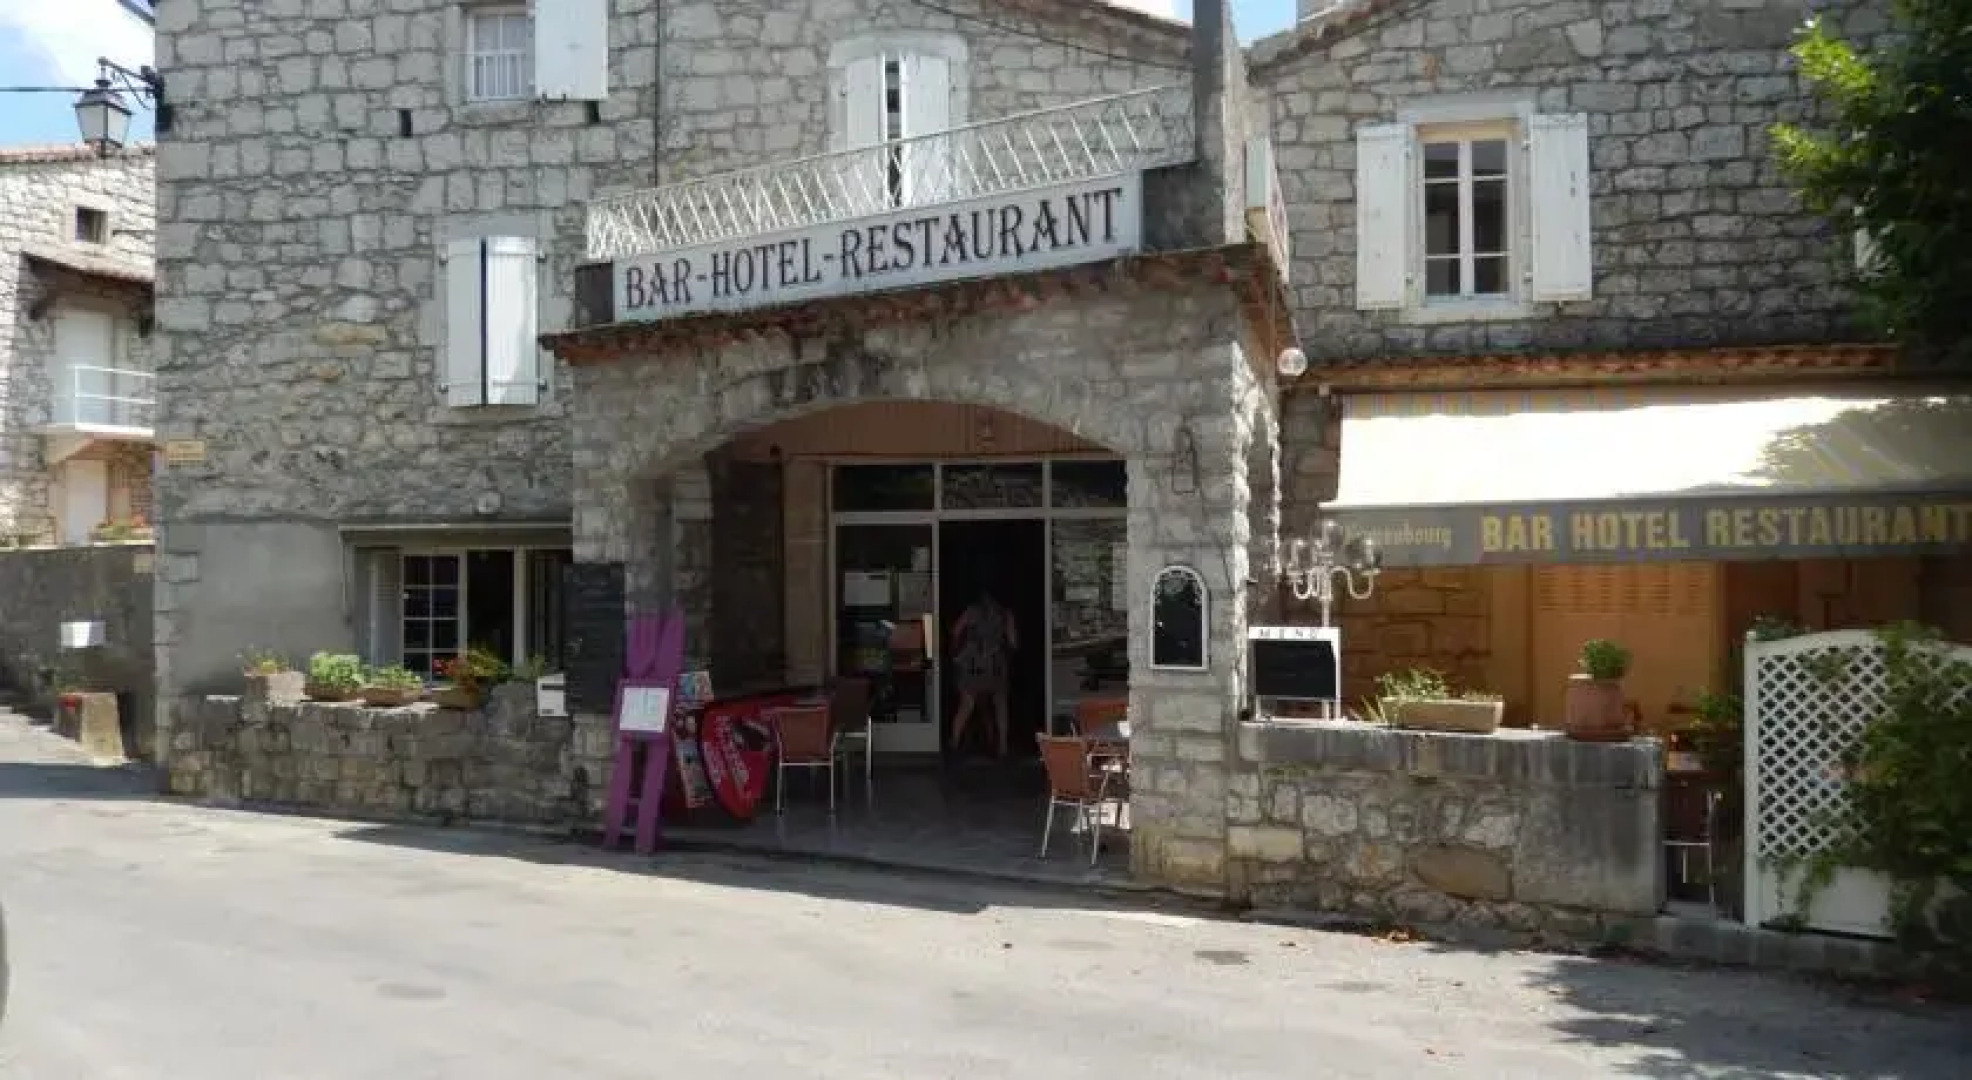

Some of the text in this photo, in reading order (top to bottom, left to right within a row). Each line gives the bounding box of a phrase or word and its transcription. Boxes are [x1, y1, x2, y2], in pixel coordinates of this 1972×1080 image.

[1482, 513, 1552, 552] BAR
[1572, 509, 1691, 551] HOTEL
[1705, 504, 1972, 546] RESTAURANT
